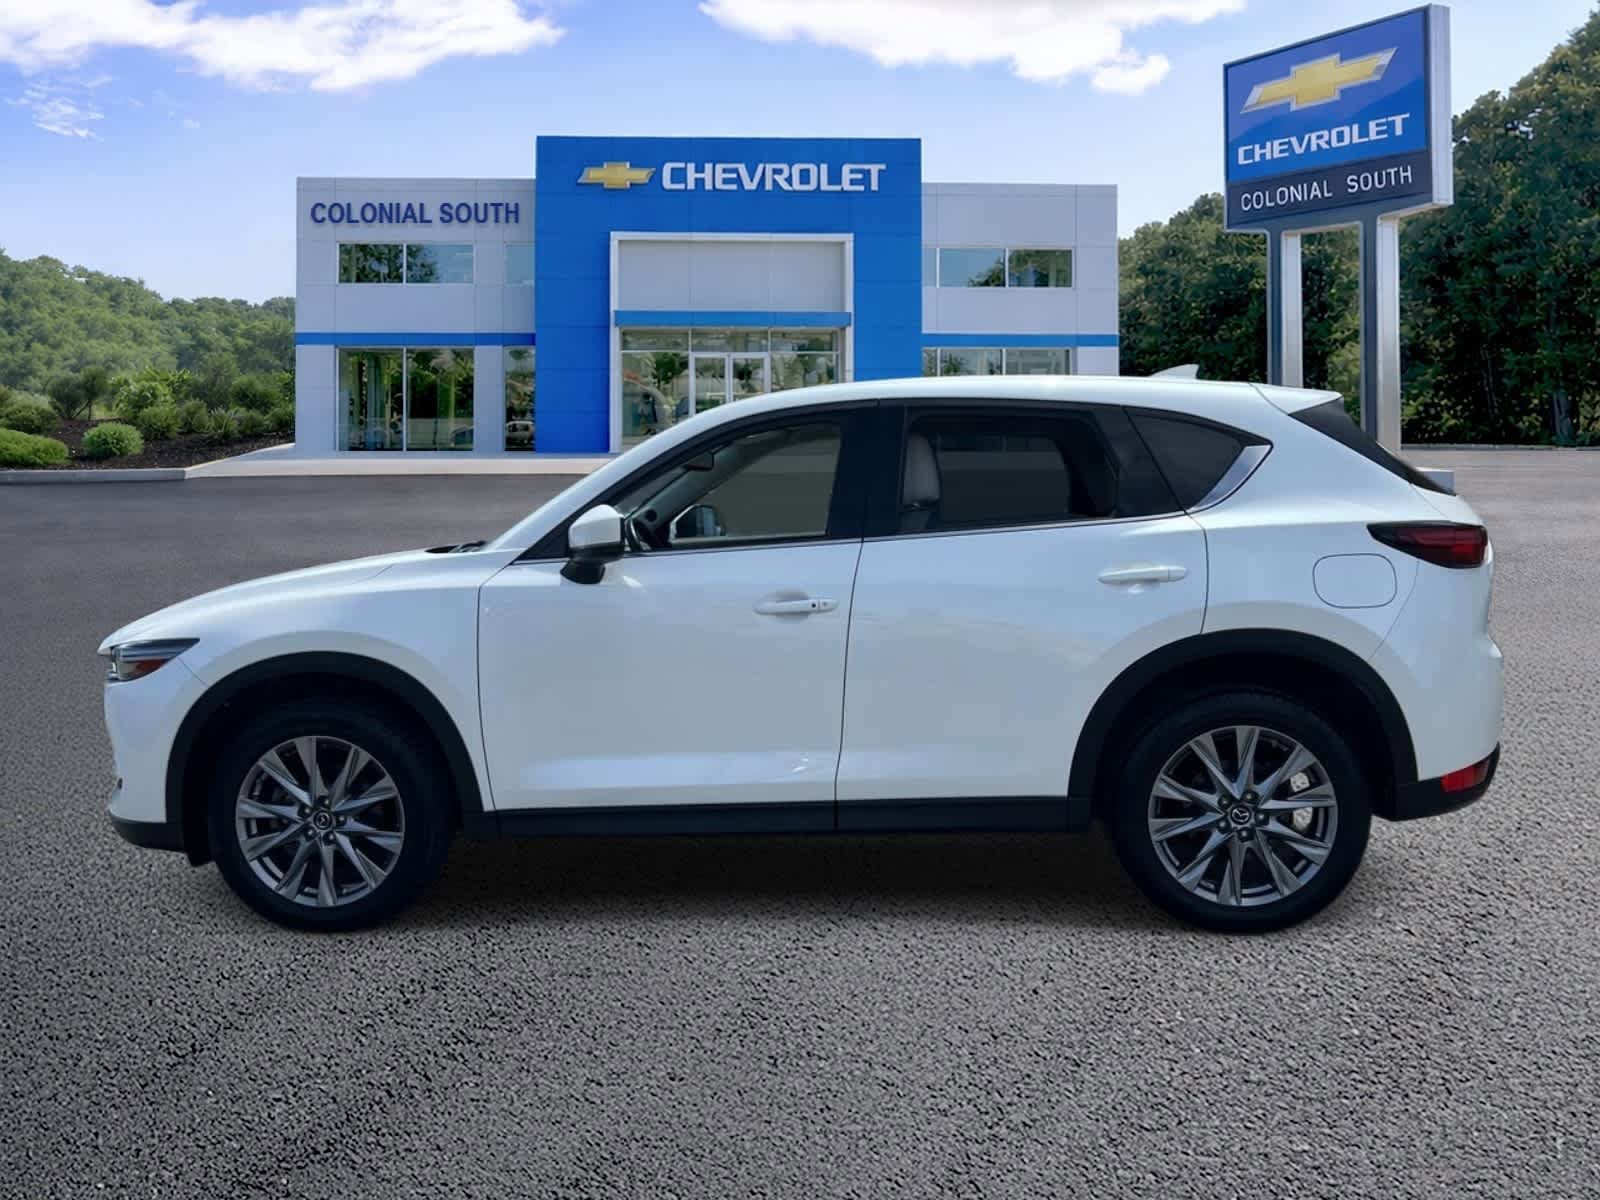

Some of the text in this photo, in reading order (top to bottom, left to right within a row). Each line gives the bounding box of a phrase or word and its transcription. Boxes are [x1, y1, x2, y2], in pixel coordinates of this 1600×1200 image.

[1238, 113, 1410, 165] CHEVROLET
[662, 162, 886, 192] CHEVROLET
[1241, 165, 1413, 211] COLONIAL SOUTH
[311, 202, 521, 225] COLONIAL SOUTH
